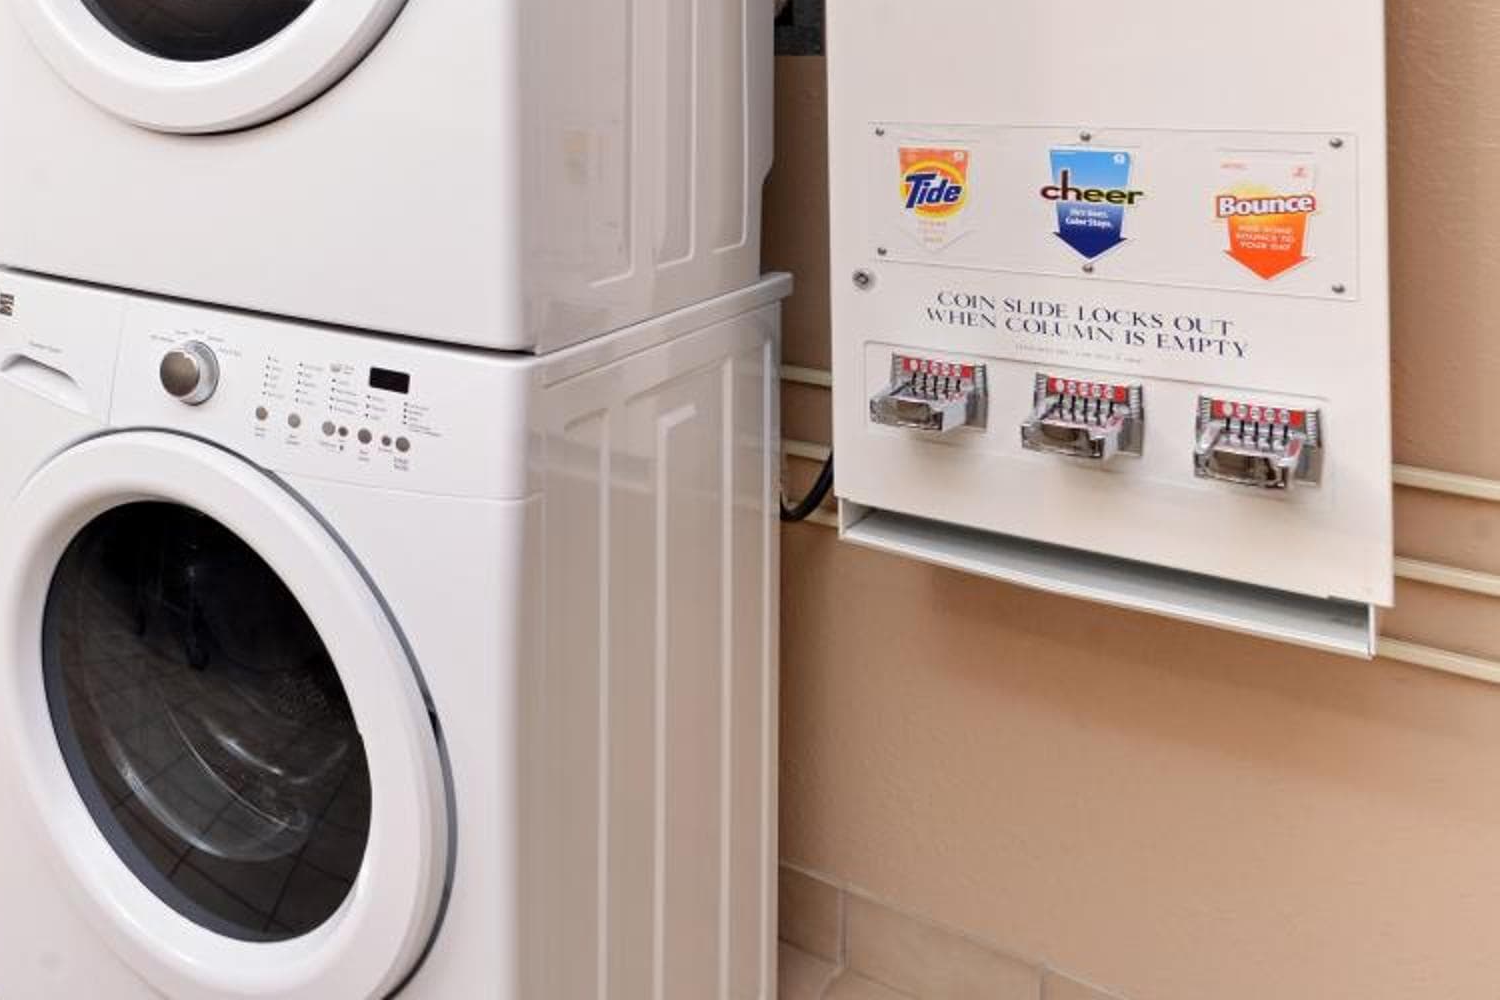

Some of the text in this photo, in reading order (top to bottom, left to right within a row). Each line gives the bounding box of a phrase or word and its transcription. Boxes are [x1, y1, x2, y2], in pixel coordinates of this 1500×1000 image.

[905, 173, 962, 209] Tide
[1041, 169, 1144, 205] cheer
[1218, 195, 1315, 217] Bounce
[937, 291, 1235, 336] COIN SLIDE LOCKS OUT
[927, 307, 997, 328] WHEN
[1005, 317, 1114, 342] COLUMN
[1125, 329, 1146, 347] IS
[1157, 333, 1249, 358] EMPTY
